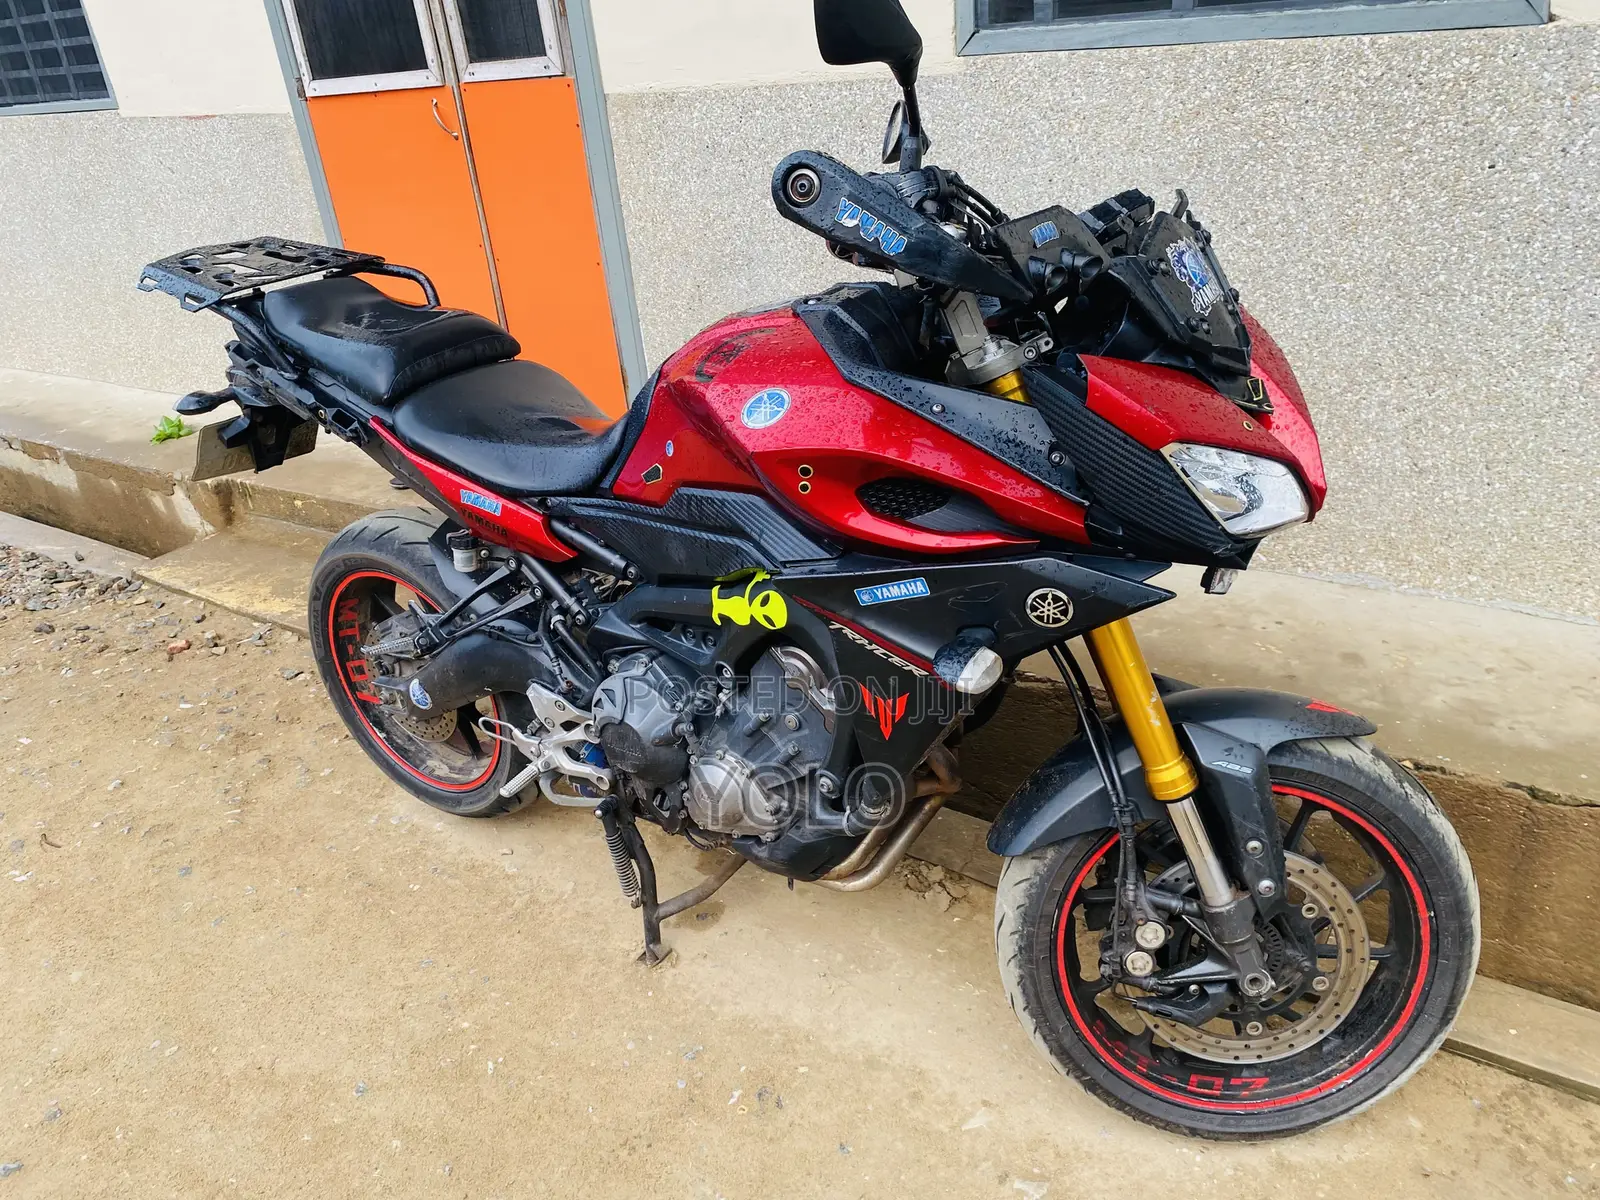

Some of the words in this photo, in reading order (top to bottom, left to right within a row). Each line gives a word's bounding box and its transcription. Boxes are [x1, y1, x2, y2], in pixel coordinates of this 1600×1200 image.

[835, 197, 907, 255] YAMAHA
[460, 489, 502, 516] YAMAHA
[461, 508, 507, 536] YAMAHA
[874, 581, 926, 599] YAMAHA
[1211, 760, 1254, 774] ABS
